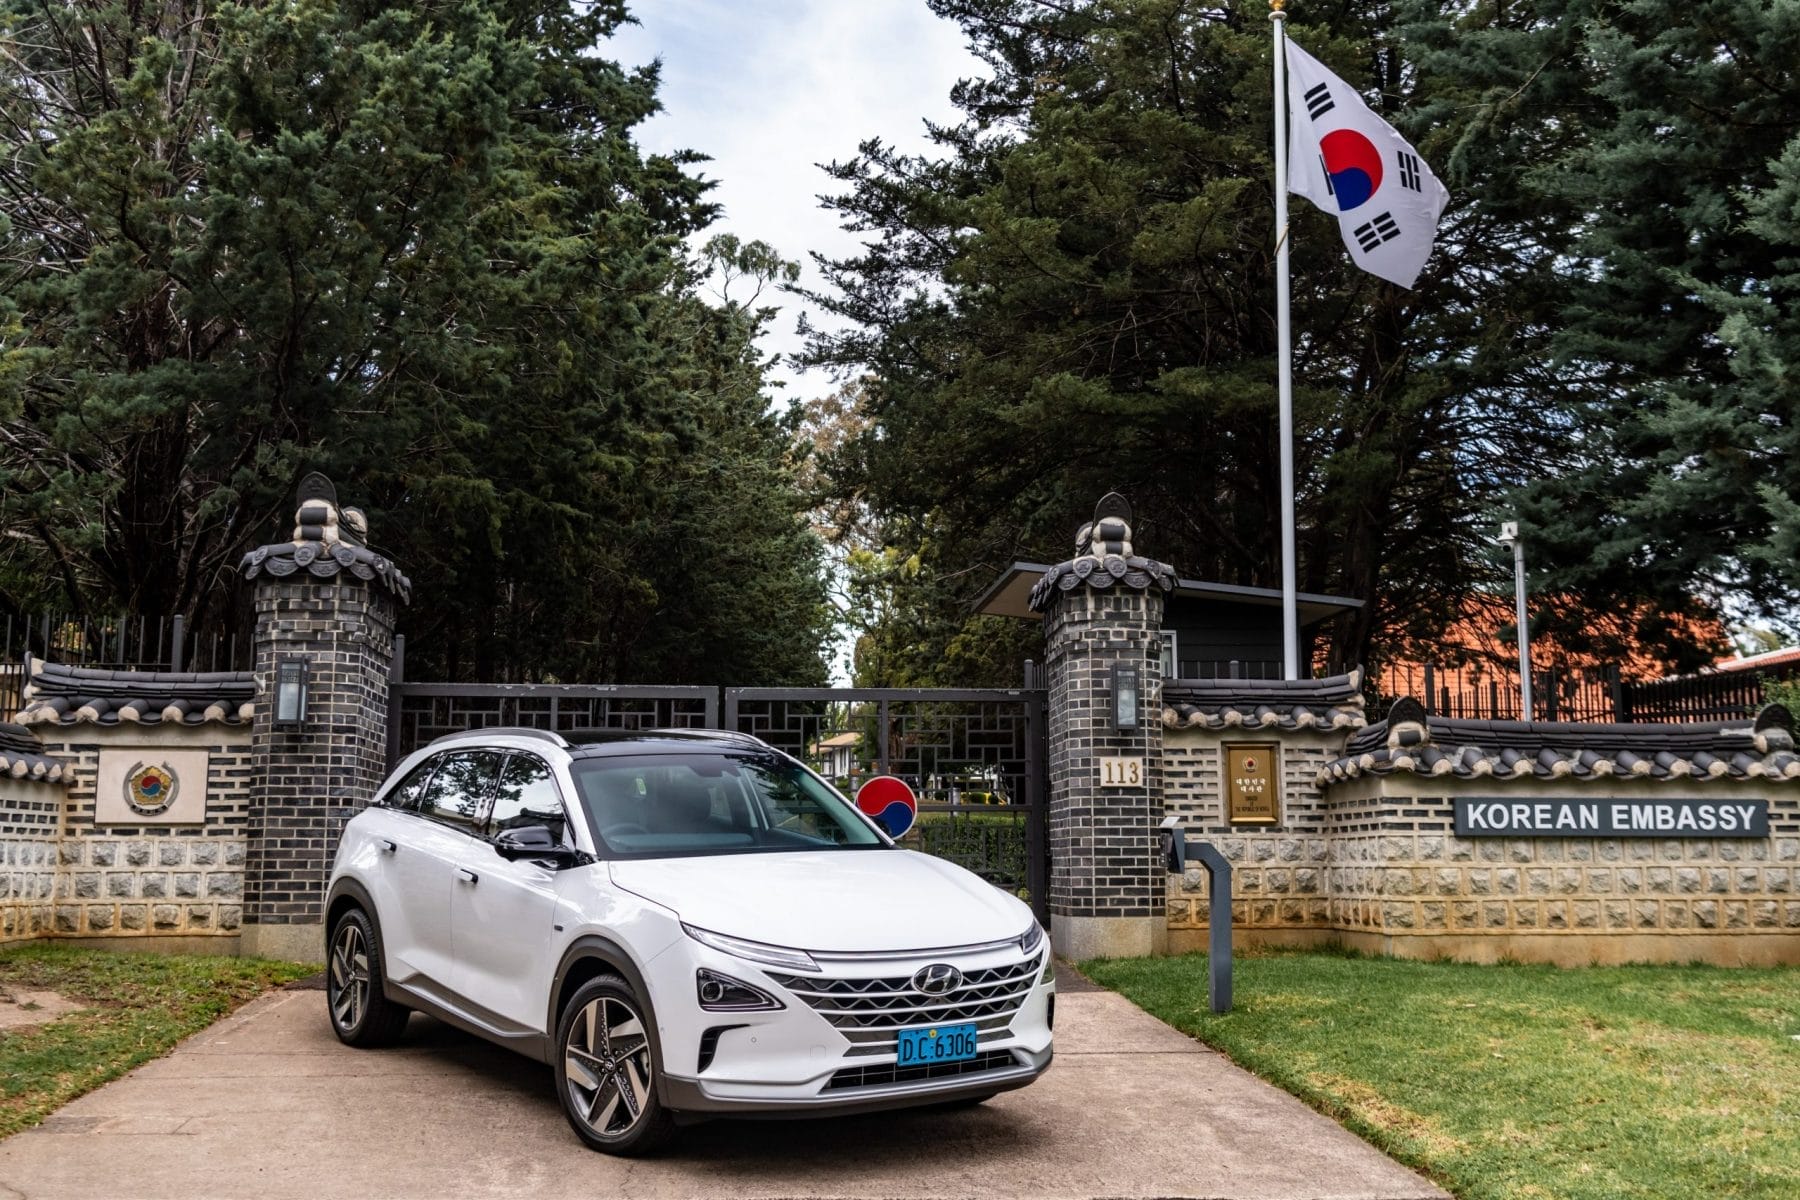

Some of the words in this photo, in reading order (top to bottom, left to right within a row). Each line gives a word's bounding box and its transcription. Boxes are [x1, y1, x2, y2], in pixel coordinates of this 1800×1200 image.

[1105, 761, 1139, 784] 113
[1467, 804, 1599, 829] KOREAN
[1611, 805, 1756, 830] EMBASSY
